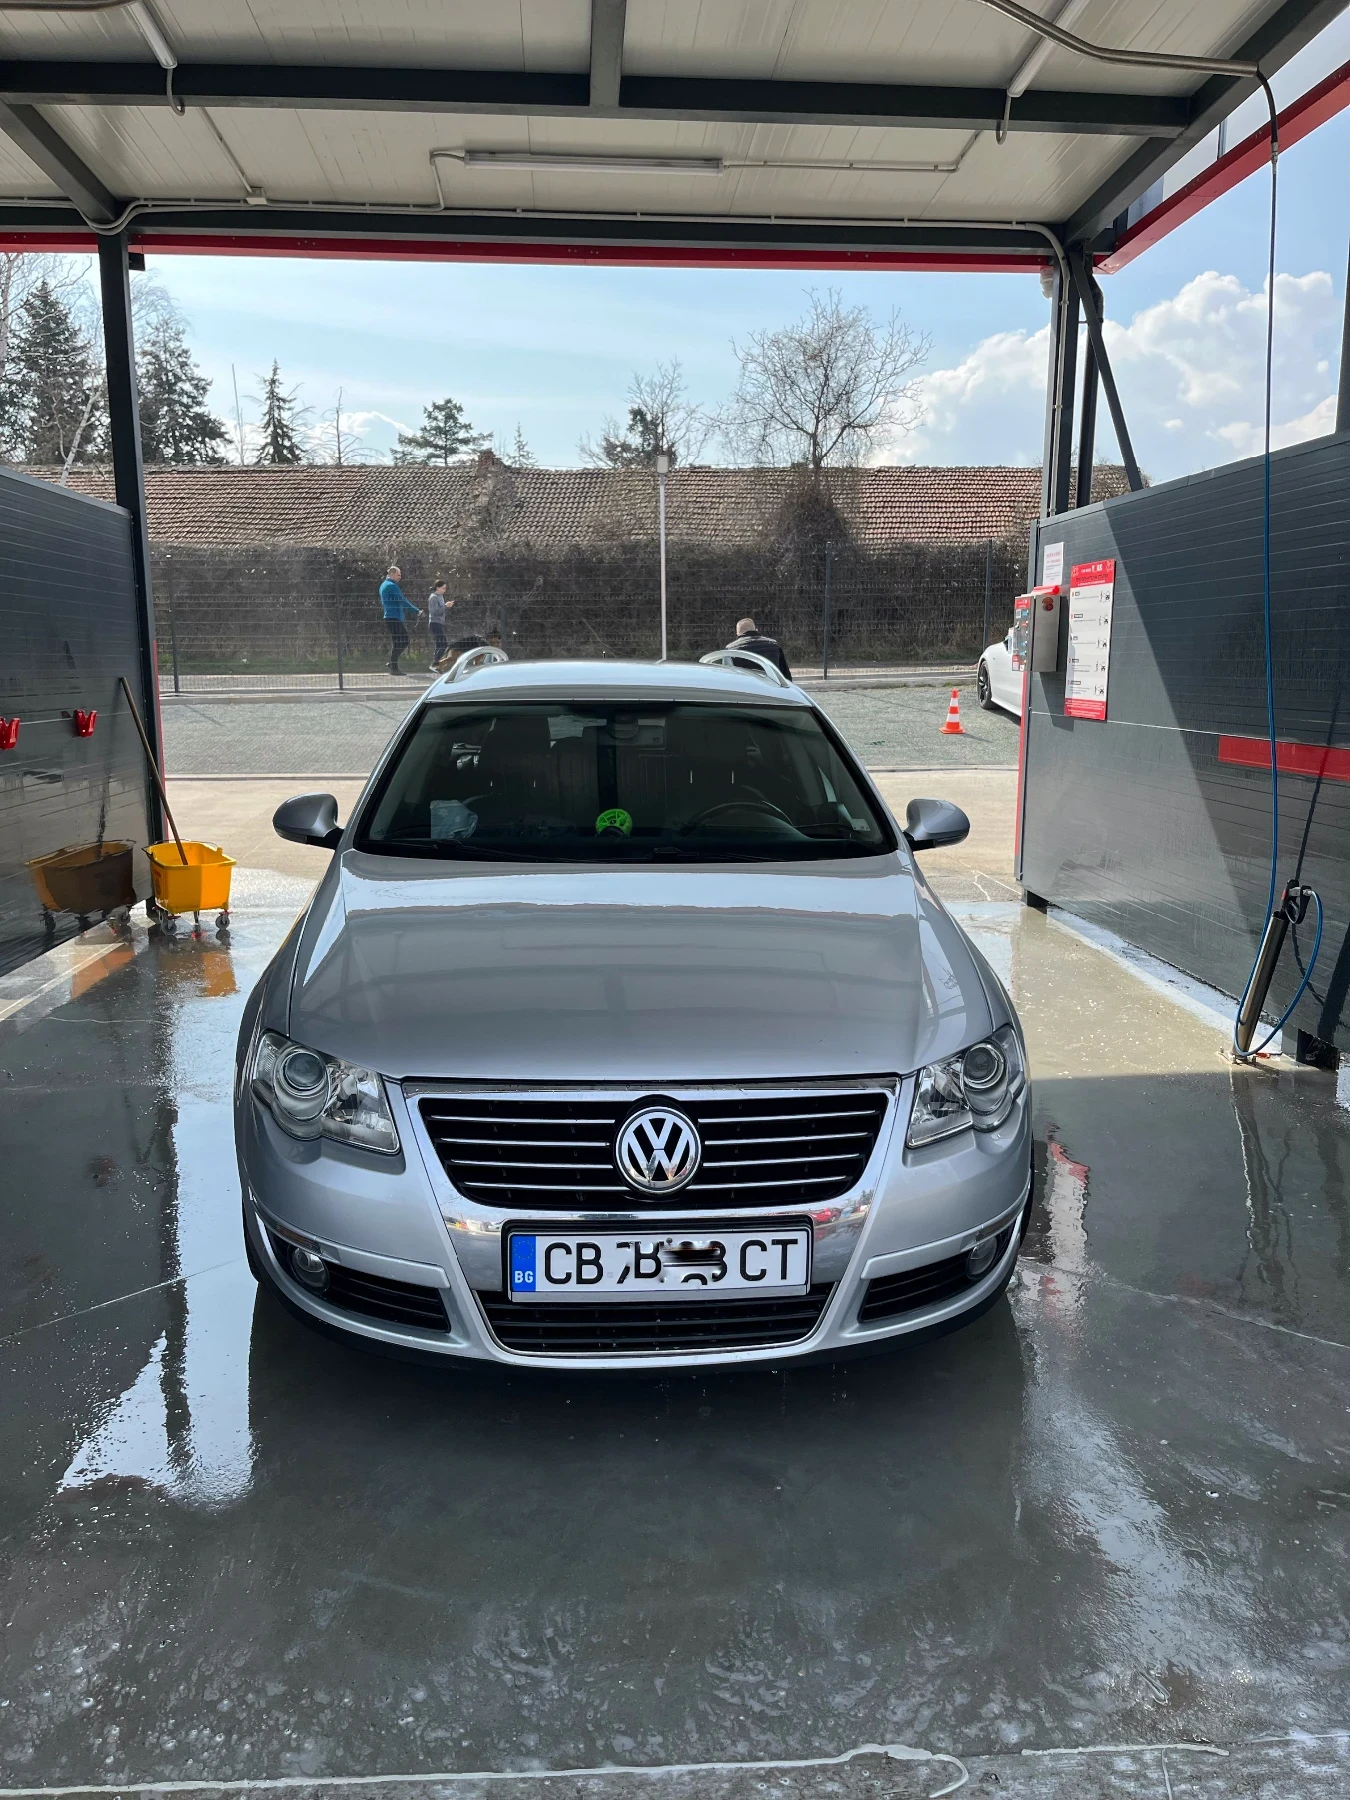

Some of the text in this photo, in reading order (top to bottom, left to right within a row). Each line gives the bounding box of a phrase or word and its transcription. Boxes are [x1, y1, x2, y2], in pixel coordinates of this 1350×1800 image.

[514, 1270, 534, 1283] BG
[544, 1241, 604, 1285] CB
[739, 1239, 799, 1282] CT
